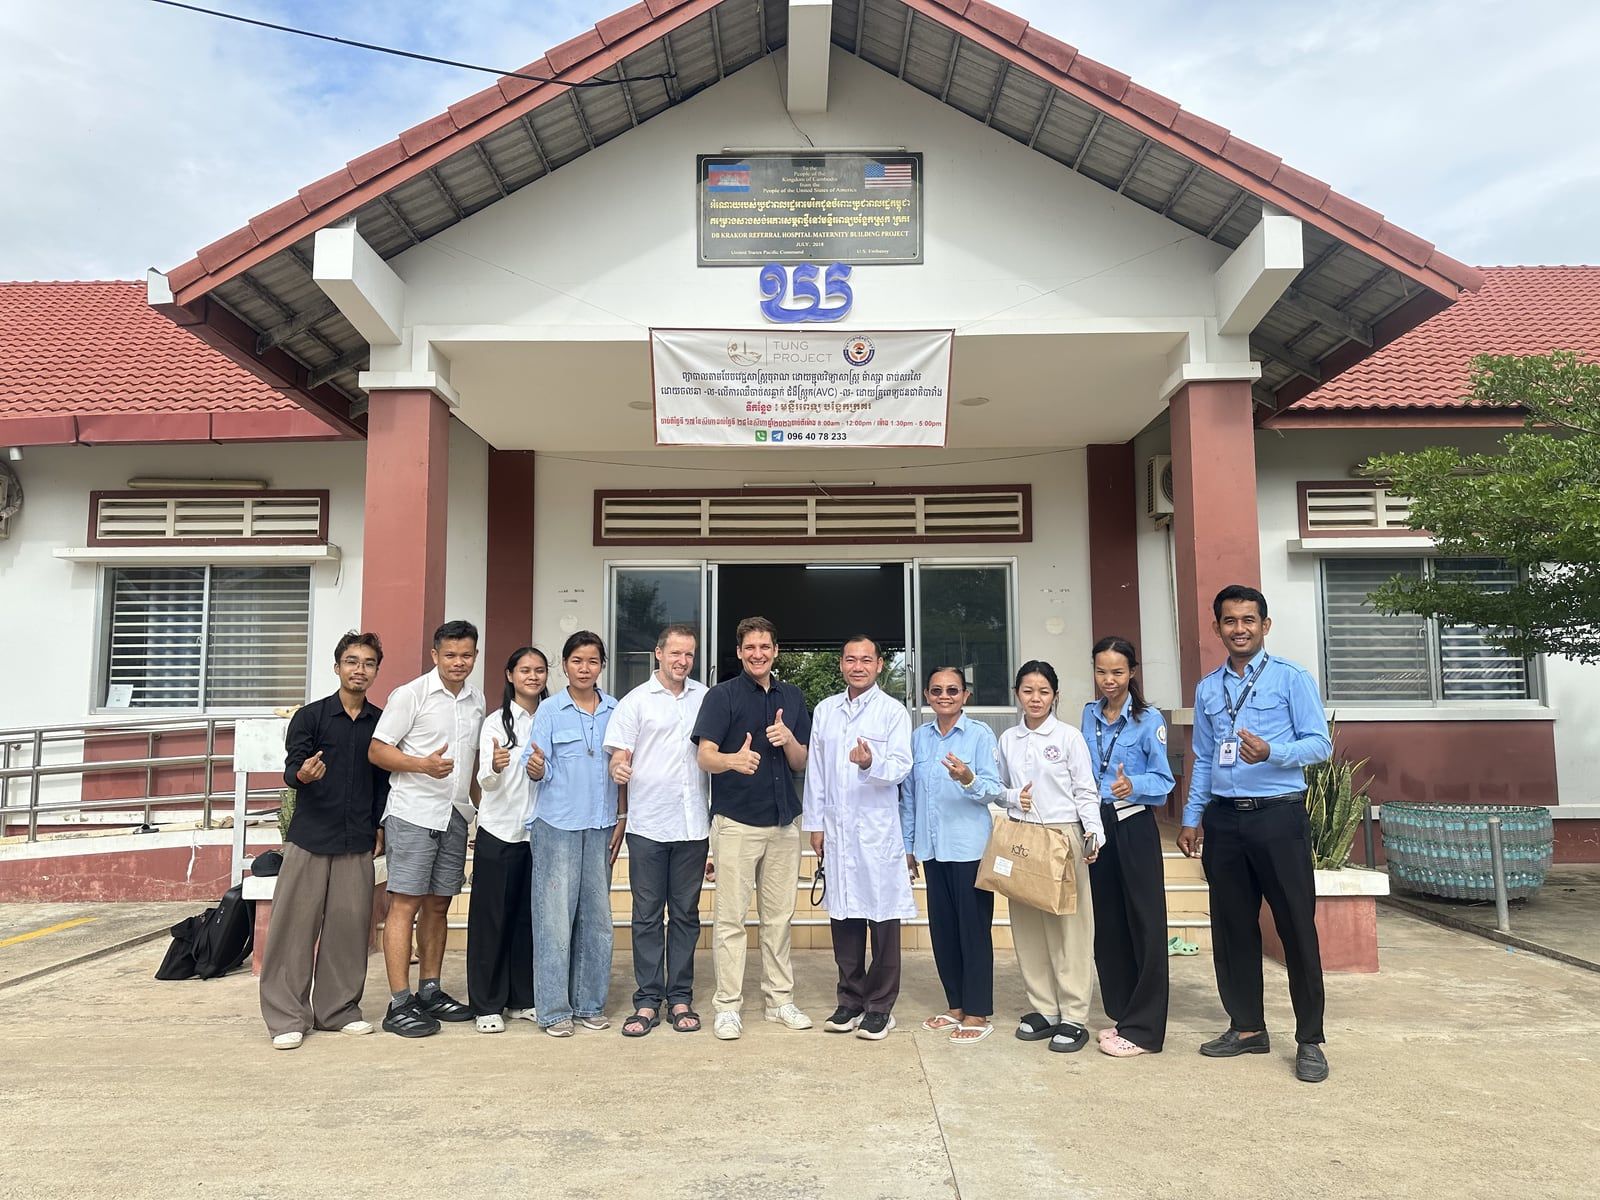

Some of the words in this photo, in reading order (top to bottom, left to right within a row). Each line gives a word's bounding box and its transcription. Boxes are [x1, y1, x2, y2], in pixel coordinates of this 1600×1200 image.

[782, 231, 812, 239] HOSPITAL
[773, 341, 809, 350] TUNG
[773, 353, 832, 363] PROJECT
[787, 432, 803, 441] 096
[805, 432, 816, 441] 40
[818, 432, 829, 441] 78
[831, 432, 847, 441] 233
